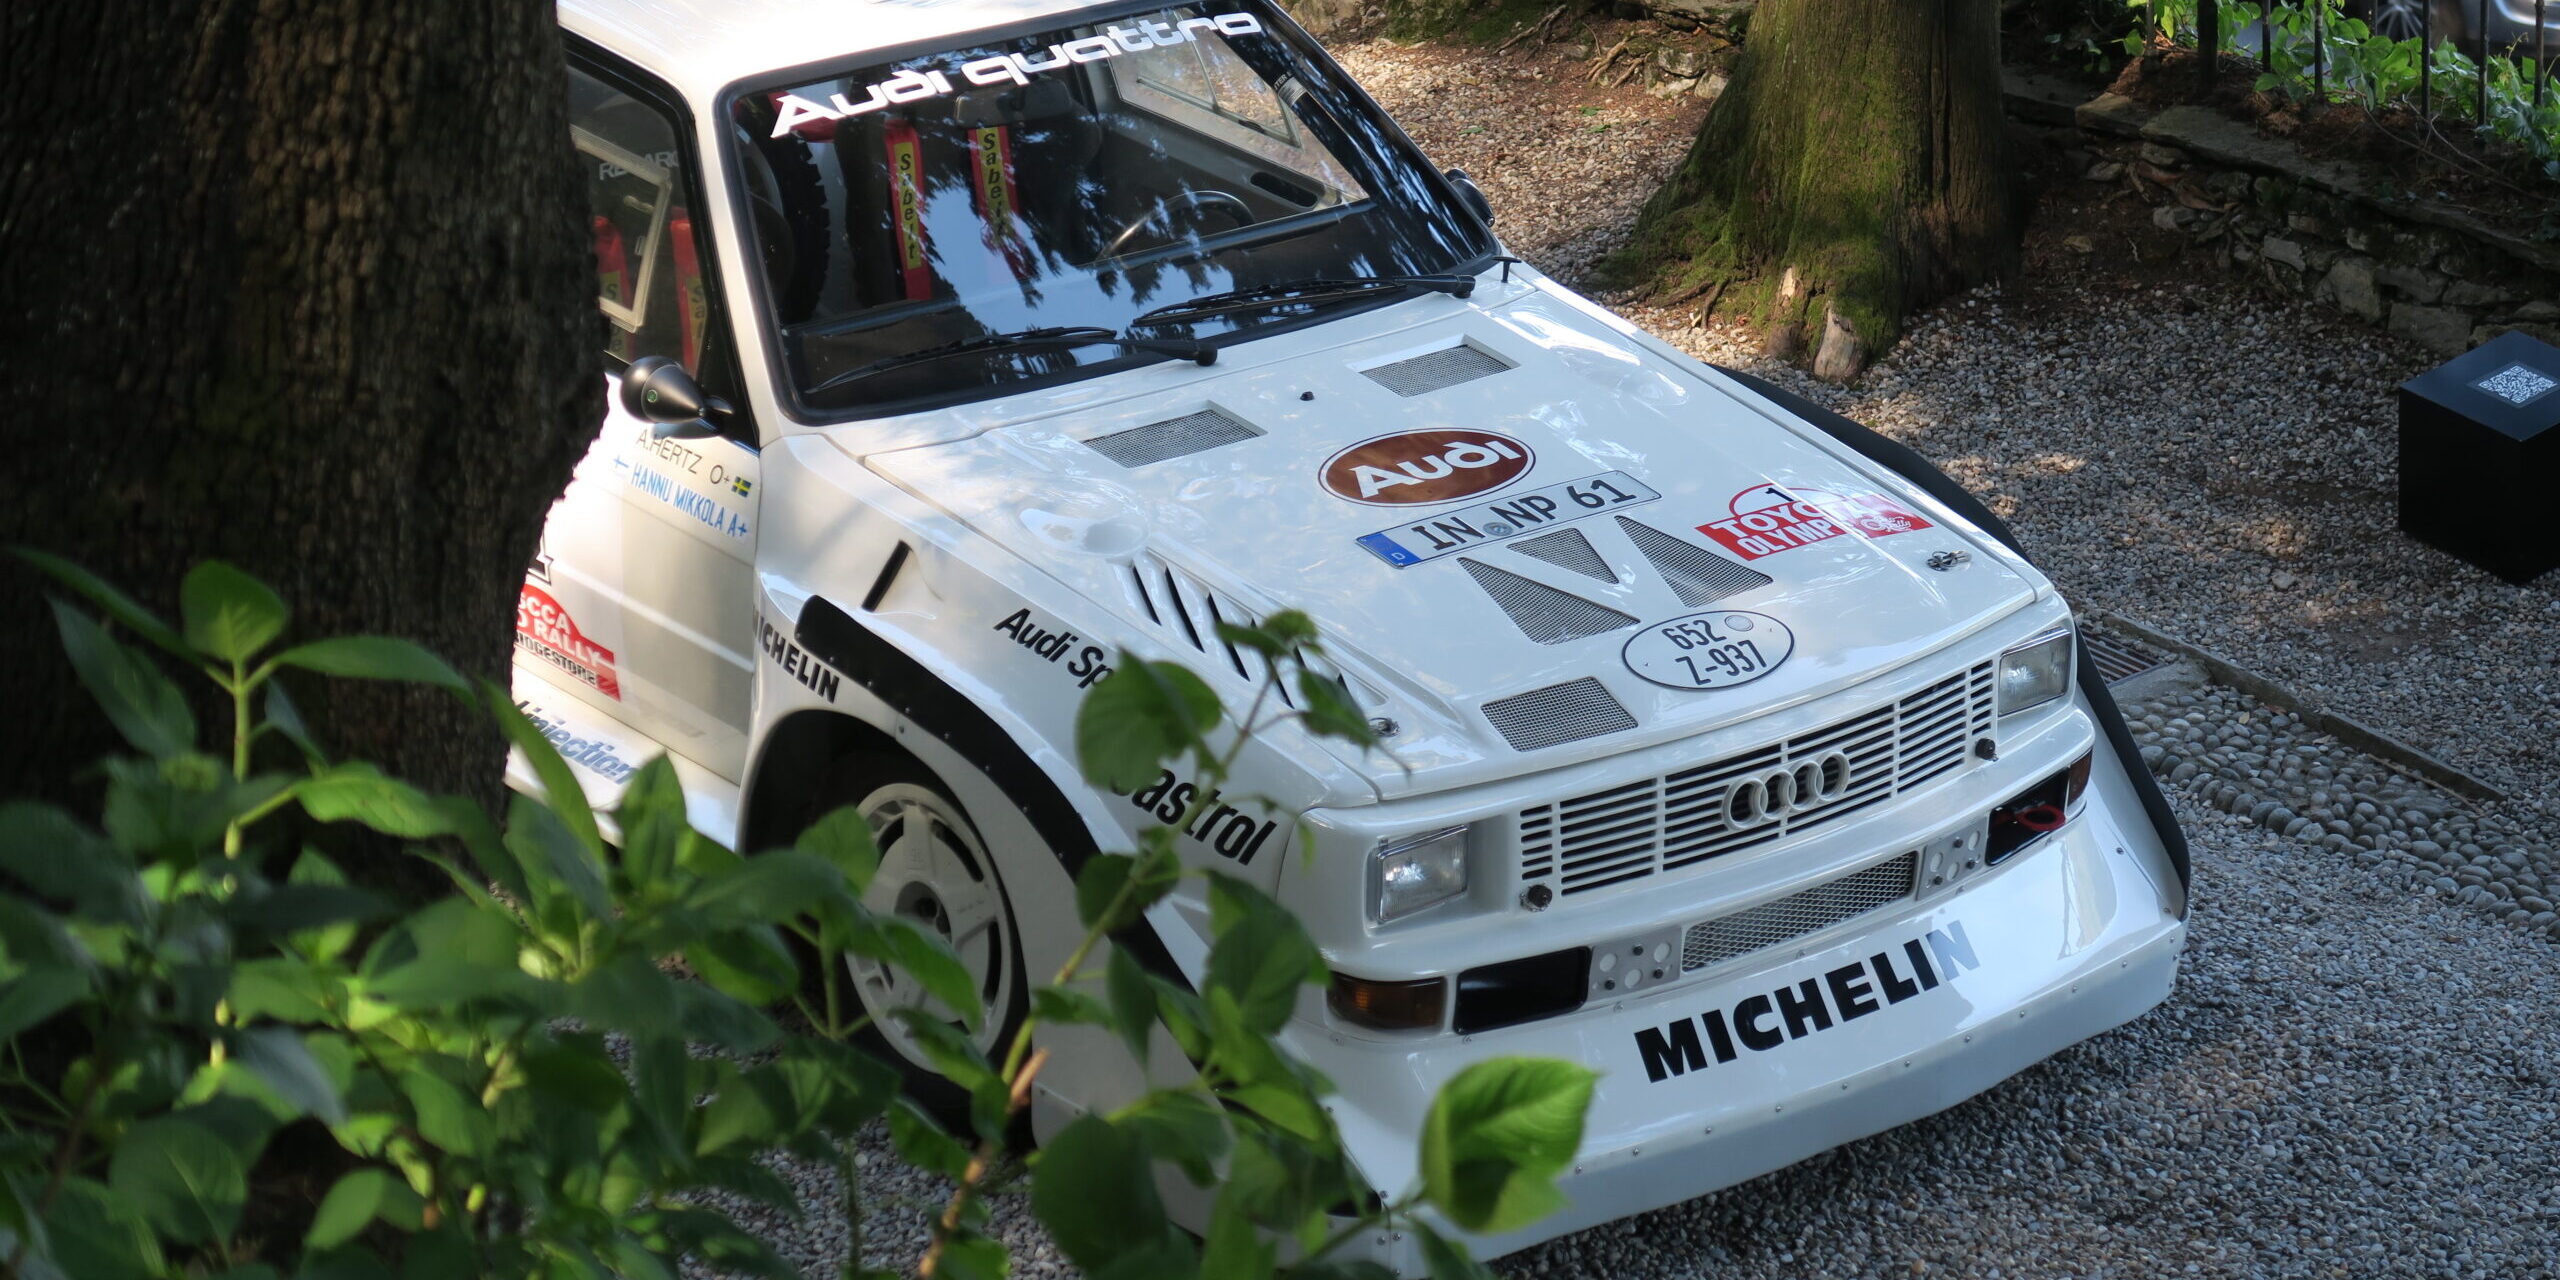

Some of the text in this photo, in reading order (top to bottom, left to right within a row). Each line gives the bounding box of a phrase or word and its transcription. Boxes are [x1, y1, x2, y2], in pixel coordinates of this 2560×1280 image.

[770, 11, 1262, 139] Audi quattro
[900, 152, 917, 260] Sabelt
[631, 461, 747, 537] HANNU MIKKOLA A+
[1348, 440, 1522, 499] Audi
[1411, 479, 1637, 551] IN NP 61
[1709, 499, 1848, 539] TOYO
[1736, 517, 1848, 556] OLYMP
[533, 617, 603, 667] RALLY
[993, 607, 1079, 663] Audi
[1661, 619, 1727, 650] 652
[1675, 639, 1767, 686] Z-937
[1110, 767, 1278, 866] astrol
[1634, 919, 1981, 1083] MICHELIN
